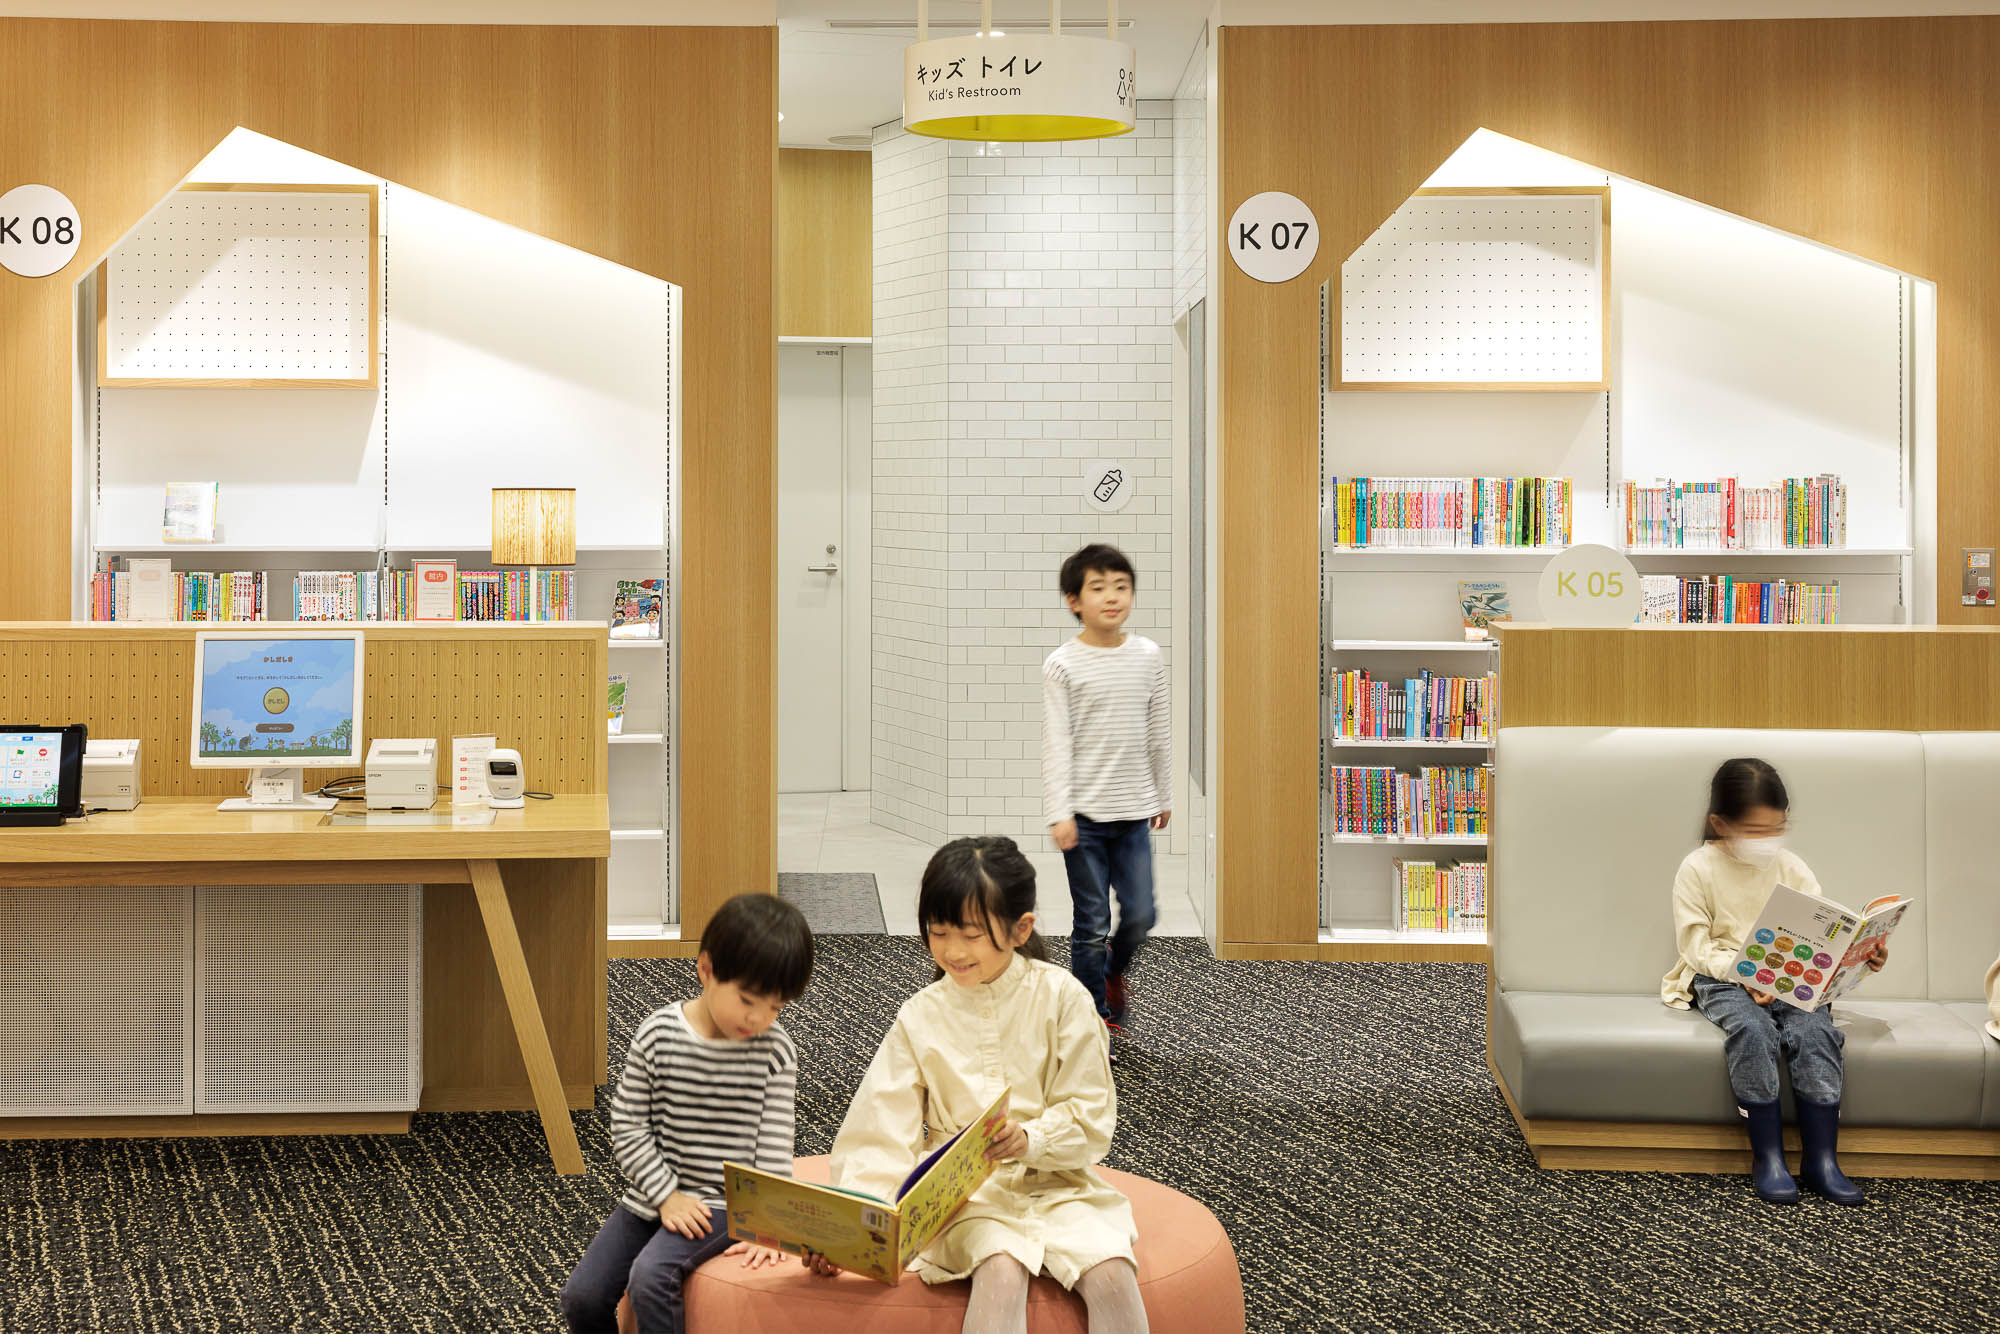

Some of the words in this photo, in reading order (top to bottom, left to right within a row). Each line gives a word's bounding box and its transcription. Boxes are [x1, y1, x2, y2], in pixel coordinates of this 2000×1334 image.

[917, 57, 966, 86] キッズ
[981, 55, 1043, 79] トイレ
[928, 88, 954, 102] Kid's
[958, 86, 1021, 99] Restroom
[0, 216, 22, 245] K
[32, 216, 74, 245] 08
[1240, 222, 1262, 251] K
[1271, 222, 1310, 251] 07
[1557, 570, 1578, 597] K
[1588, 570, 1624, 598] 05
